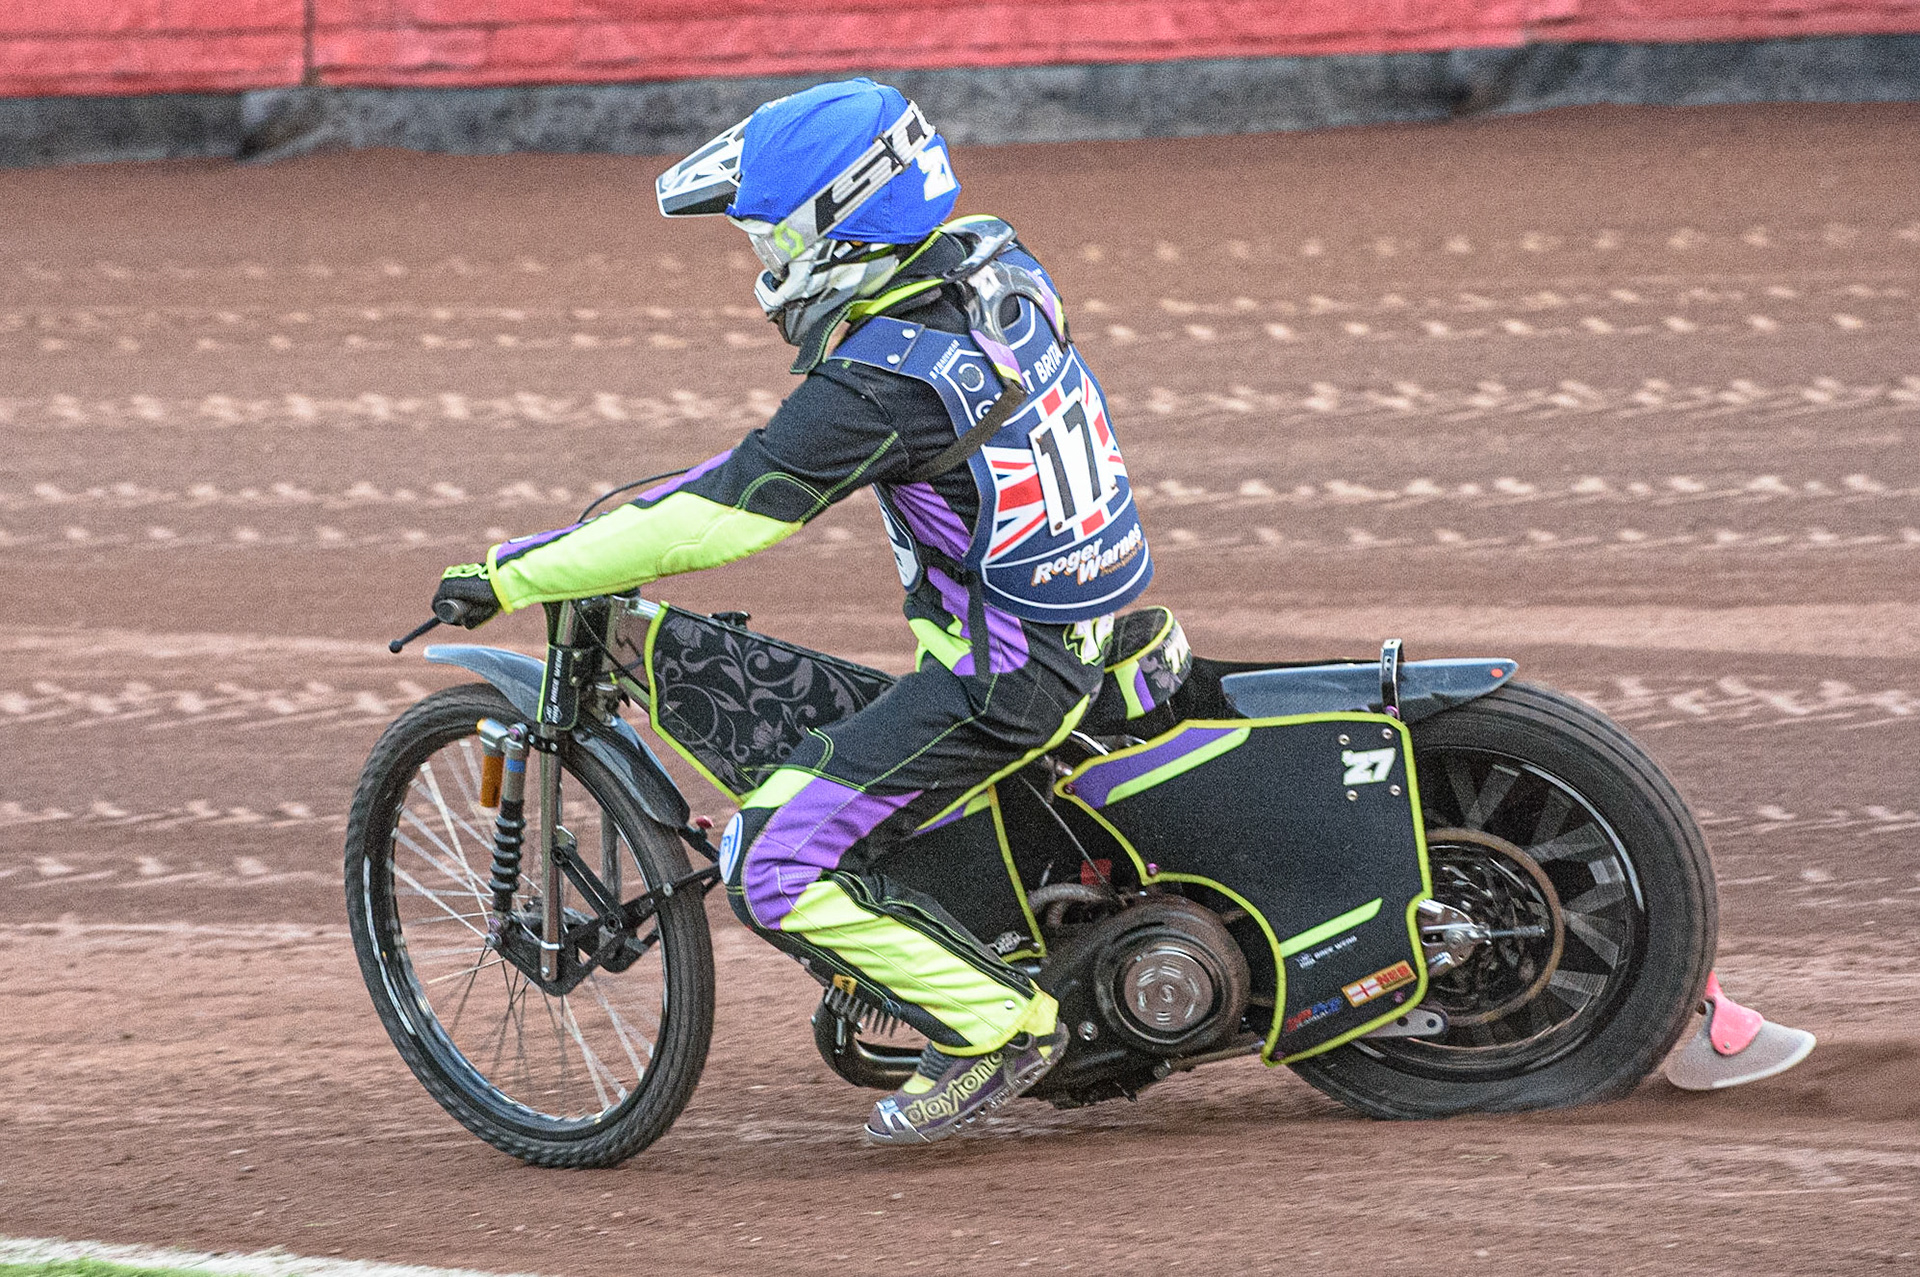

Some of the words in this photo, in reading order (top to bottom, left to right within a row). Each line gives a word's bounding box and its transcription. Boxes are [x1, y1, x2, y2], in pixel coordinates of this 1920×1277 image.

[1038, 403, 1102, 521] 17
[1031, 538, 1103, 587] Roger
[1077, 523, 1144, 586] Warnes
